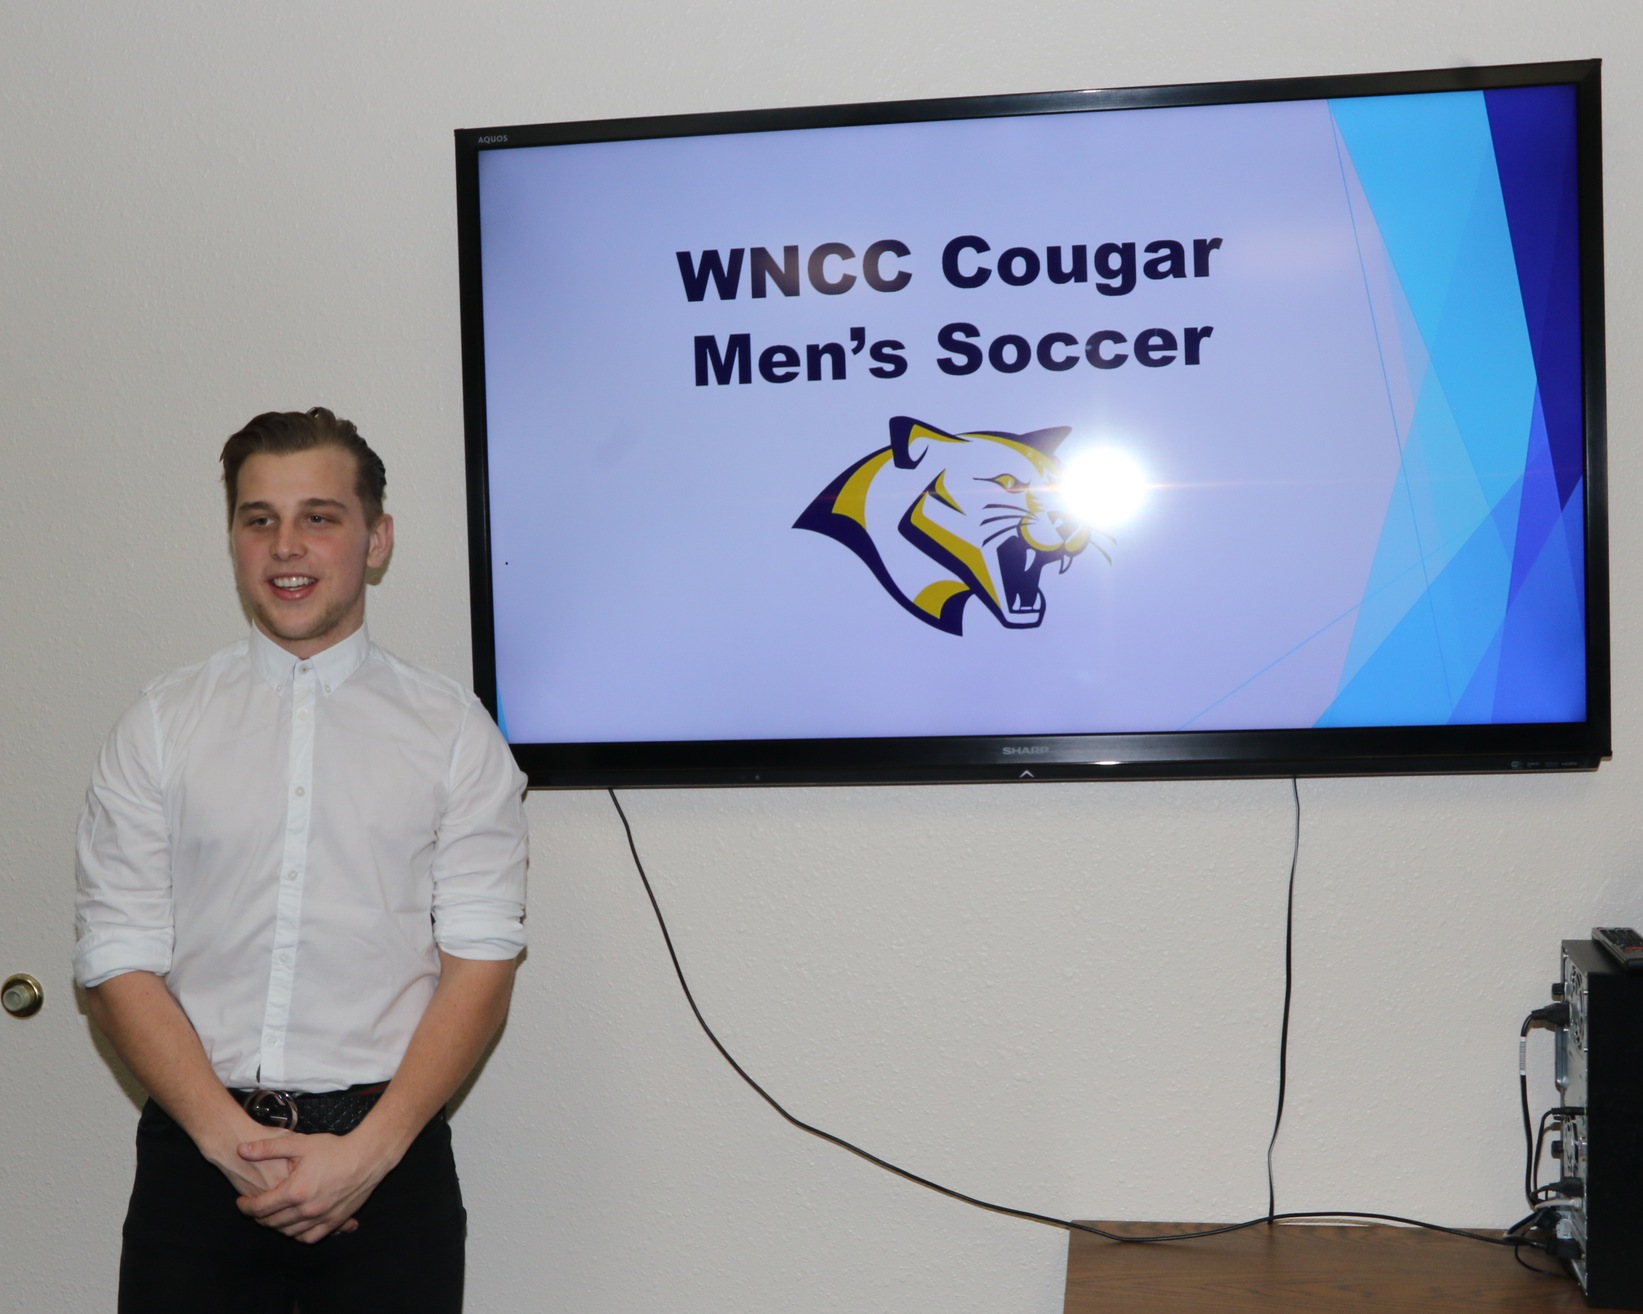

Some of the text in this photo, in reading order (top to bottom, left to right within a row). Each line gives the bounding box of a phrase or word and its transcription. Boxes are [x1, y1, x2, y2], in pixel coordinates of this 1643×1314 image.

[478, 135, 508, 144] AQUOS
[676, 235, 1223, 302] WNCC Cougar
[694, 322, 1214, 386] Men’s Soccer
[1002, 746, 1049, 755] SHARP
